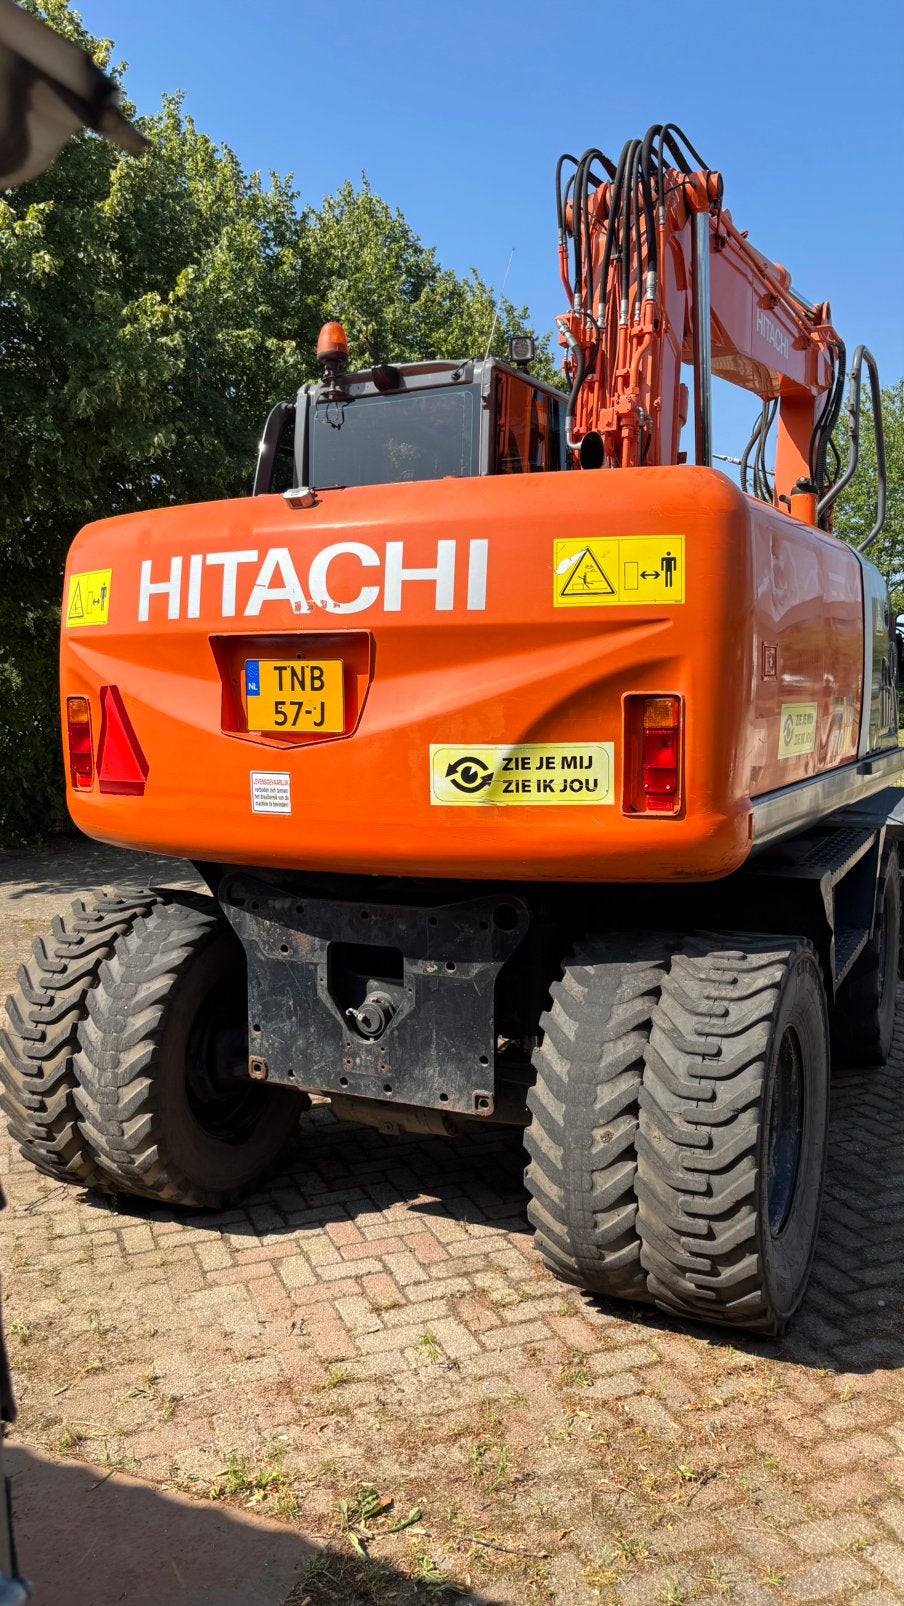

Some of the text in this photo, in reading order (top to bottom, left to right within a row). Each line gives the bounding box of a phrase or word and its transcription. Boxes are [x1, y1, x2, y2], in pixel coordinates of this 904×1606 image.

[756, 309, 789, 360] HITACHI
[138, 538, 489, 622] HITACHI
[248, 682, 258, 691] NL
[273, 665, 325, 692] TNB
[274, 701, 325, 727] 57-J
[502, 755, 593, 771] ZIE JE MIJ
[502, 778, 598, 793] ZIE IK JOU
